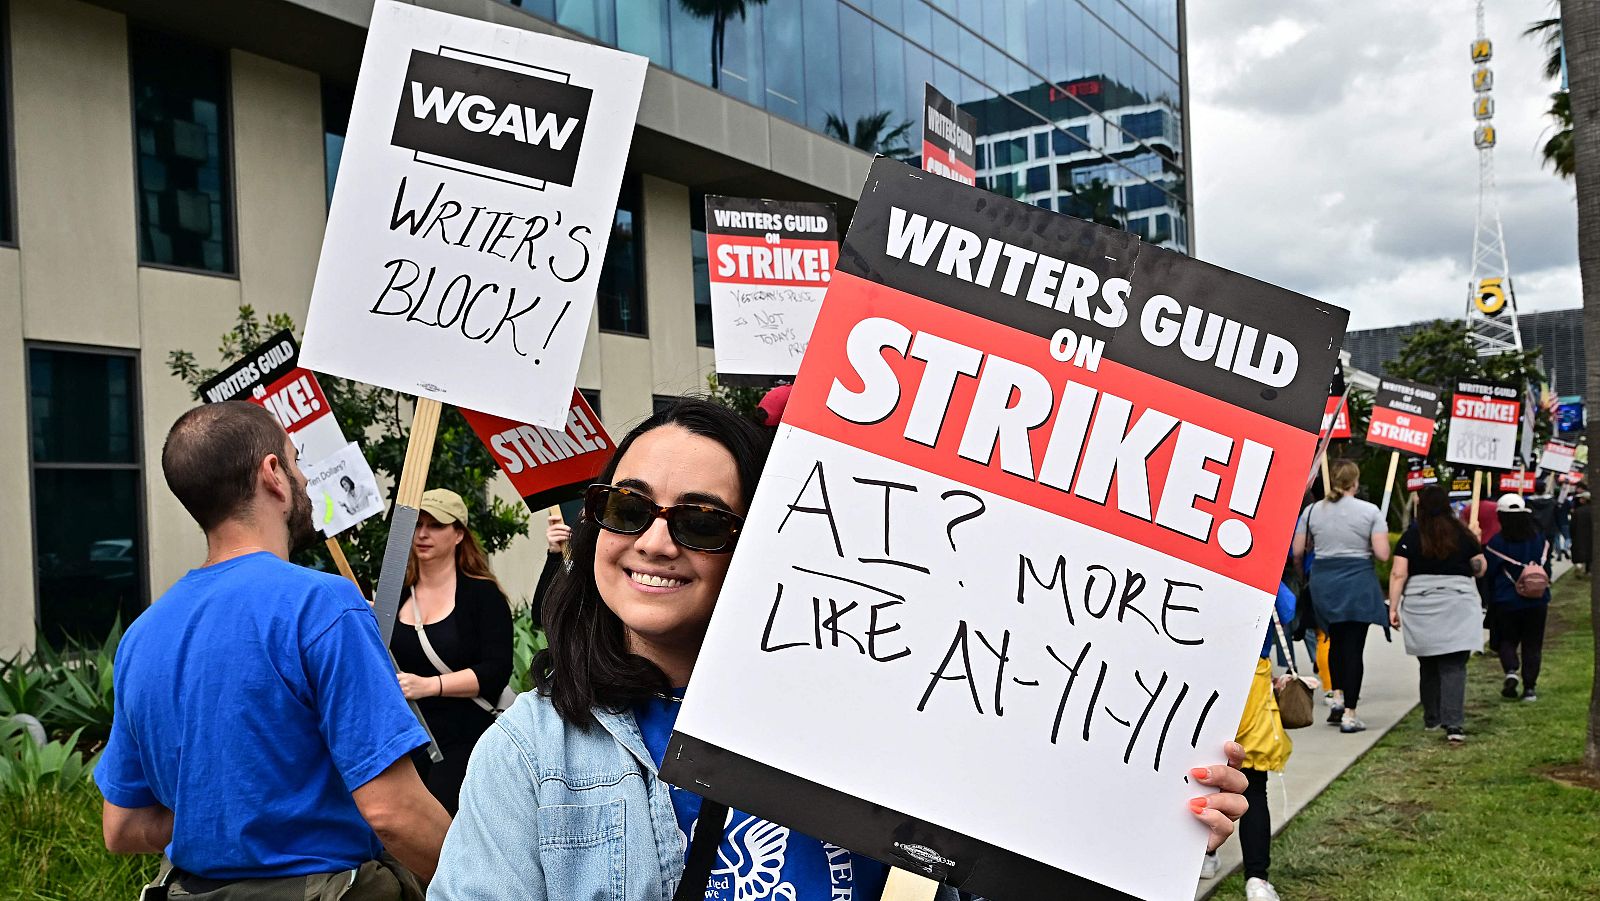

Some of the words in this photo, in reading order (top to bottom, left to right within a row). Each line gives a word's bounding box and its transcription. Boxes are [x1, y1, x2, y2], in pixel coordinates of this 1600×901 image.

[411, 81, 579, 151] WGAW
[928, 105, 957, 145] WRITERS
[389, 176, 592, 282] WRITER'S
[714, 210, 782, 231] WRITERS
[784, 214, 828, 233] GUILD
[765, 232, 780, 245] ON
[717, 244, 831, 283] STRIKE!
[368, 258, 571, 365] BLOCK!
[885, 205, 1132, 329] WRITERS
[1140, 294, 1300, 389] GUILD
[1474, 277, 1505, 314] 5
[1049, 327, 1106, 373] ON
[206, 363, 261, 403] WRITERS
[257, 340, 294, 374] GUILD
[1458, 382, 1493, 396] WRITERS
[1493, 387, 1518, 398] GUILD
[252, 383, 268, 400] ON
[1382, 381, 1415, 396] WRITERS
[1415, 389, 1437, 401] GUILD
[1389, 400, 1422, 415] AMERICA
[1396, 416, 1410, 427] ON
[1455, 399, 1516, 423] STRIKE!
[826, 316, 1275, 559] STRIKE!
[1371, 421, 1429, 448] STRIKE!
[1016, 554, 1205, 645] MORE
[760, 583, 912, 662] LIKE
[706, 876, 729, 890] ited
